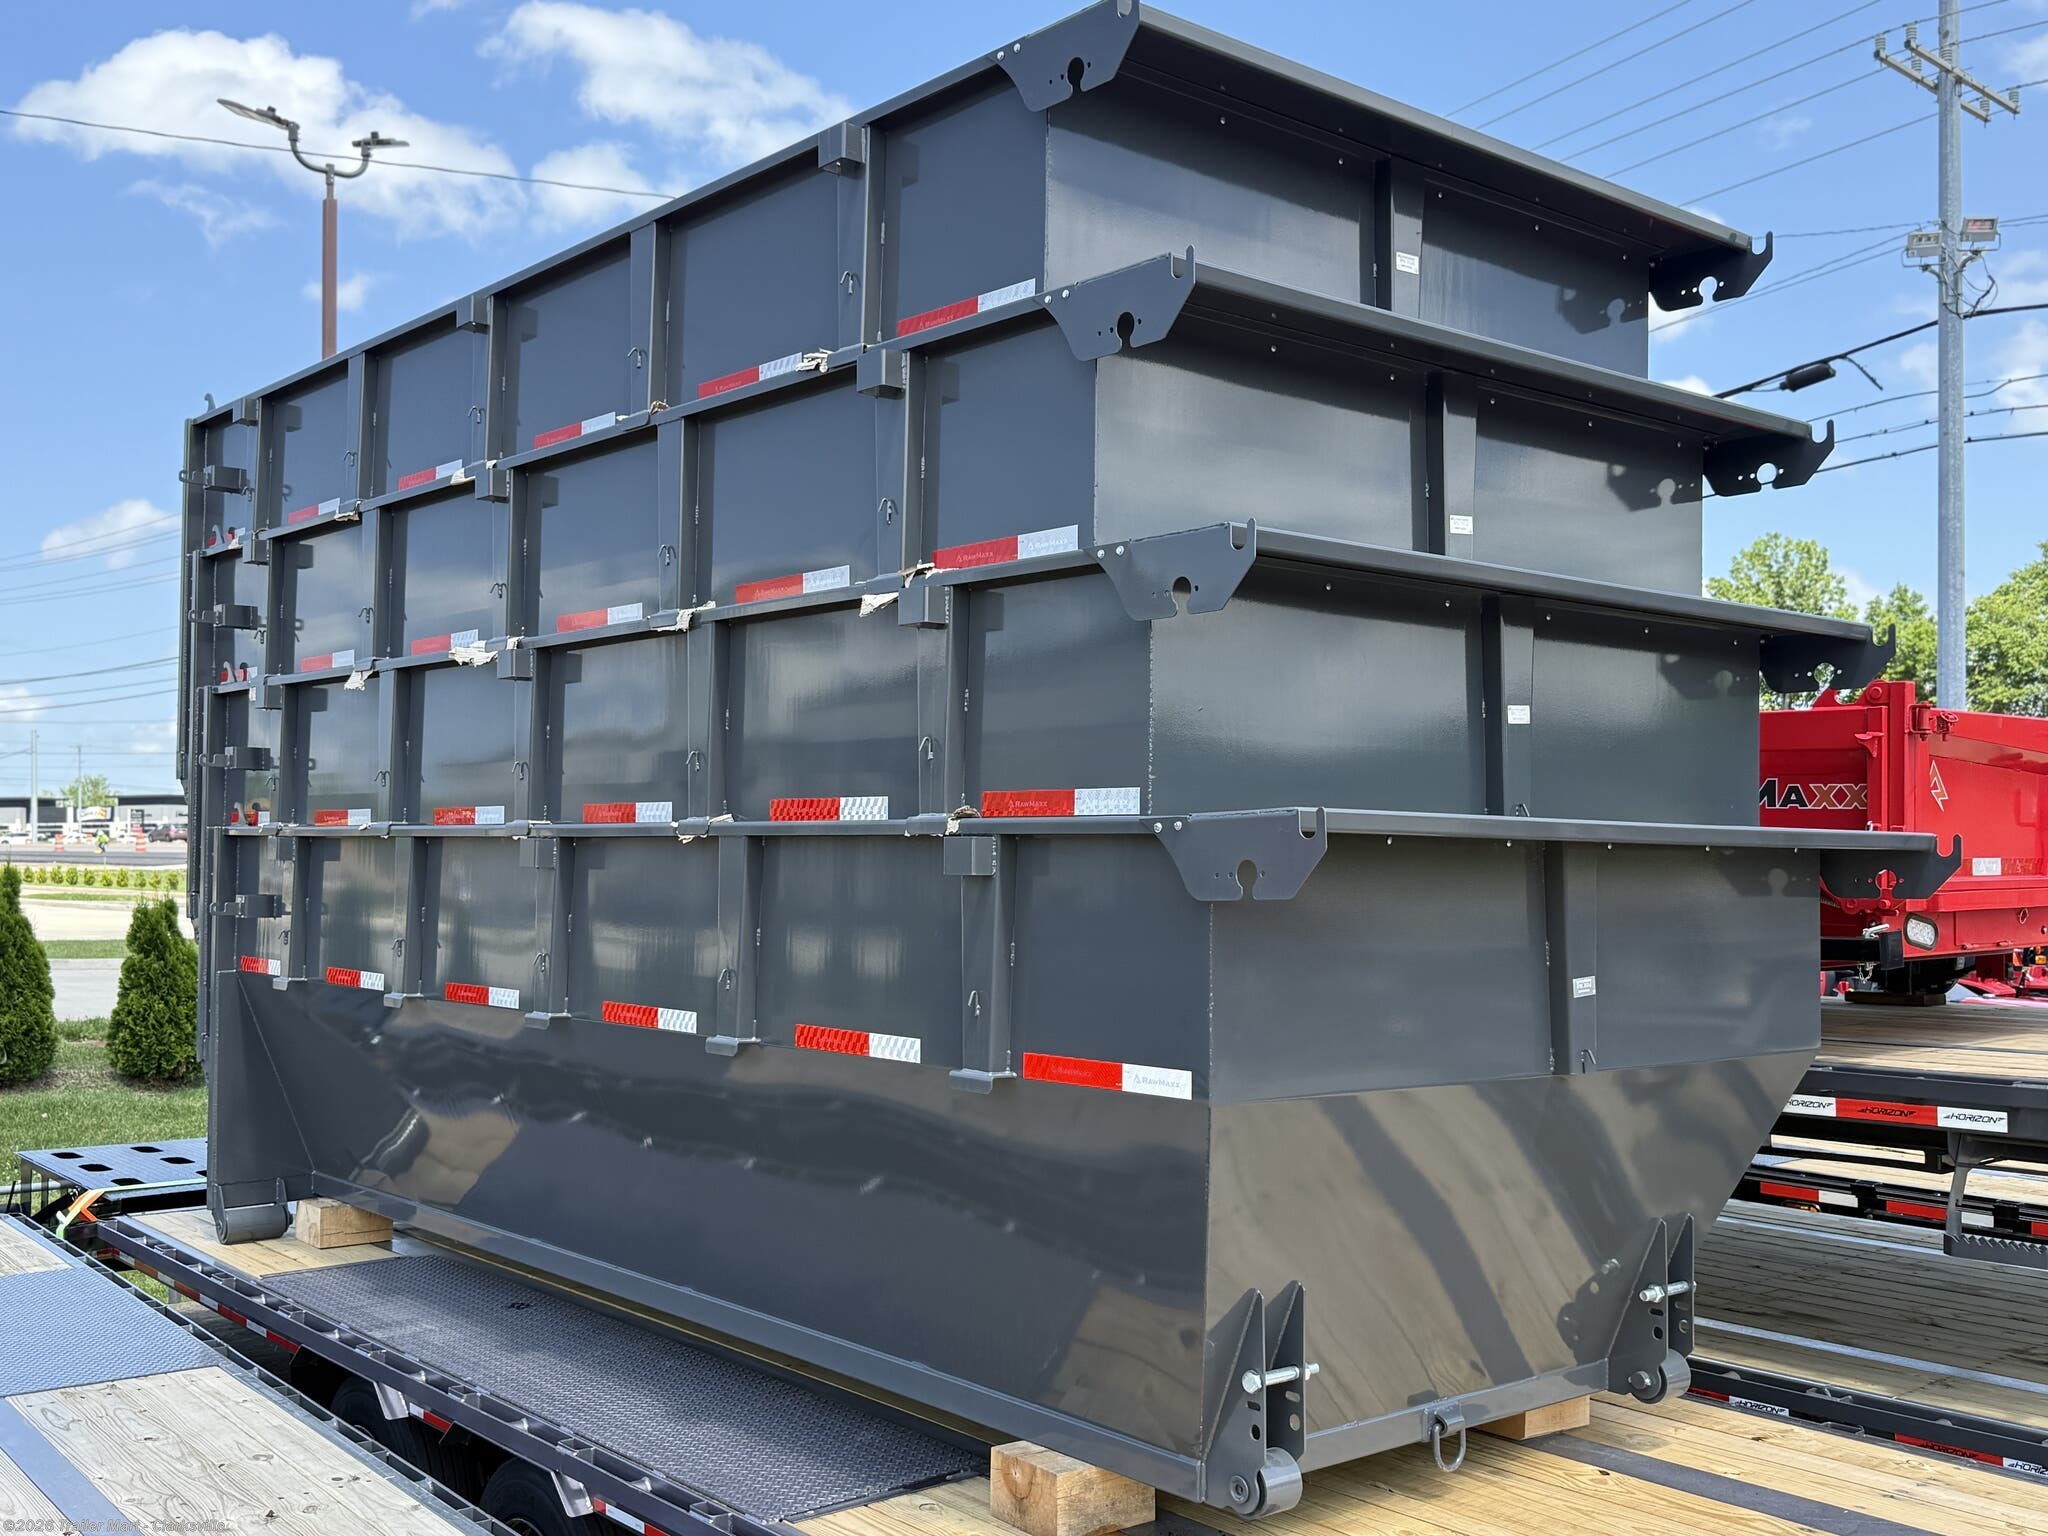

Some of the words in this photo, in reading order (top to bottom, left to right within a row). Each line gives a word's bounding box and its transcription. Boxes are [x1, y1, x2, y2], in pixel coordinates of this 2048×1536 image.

[1864, 1106, 1910, 1118] HORIZON
[1951, 1113, 1998, 1124] HORIZON
[1739, 1399, 1780, 1415] HORIZON
